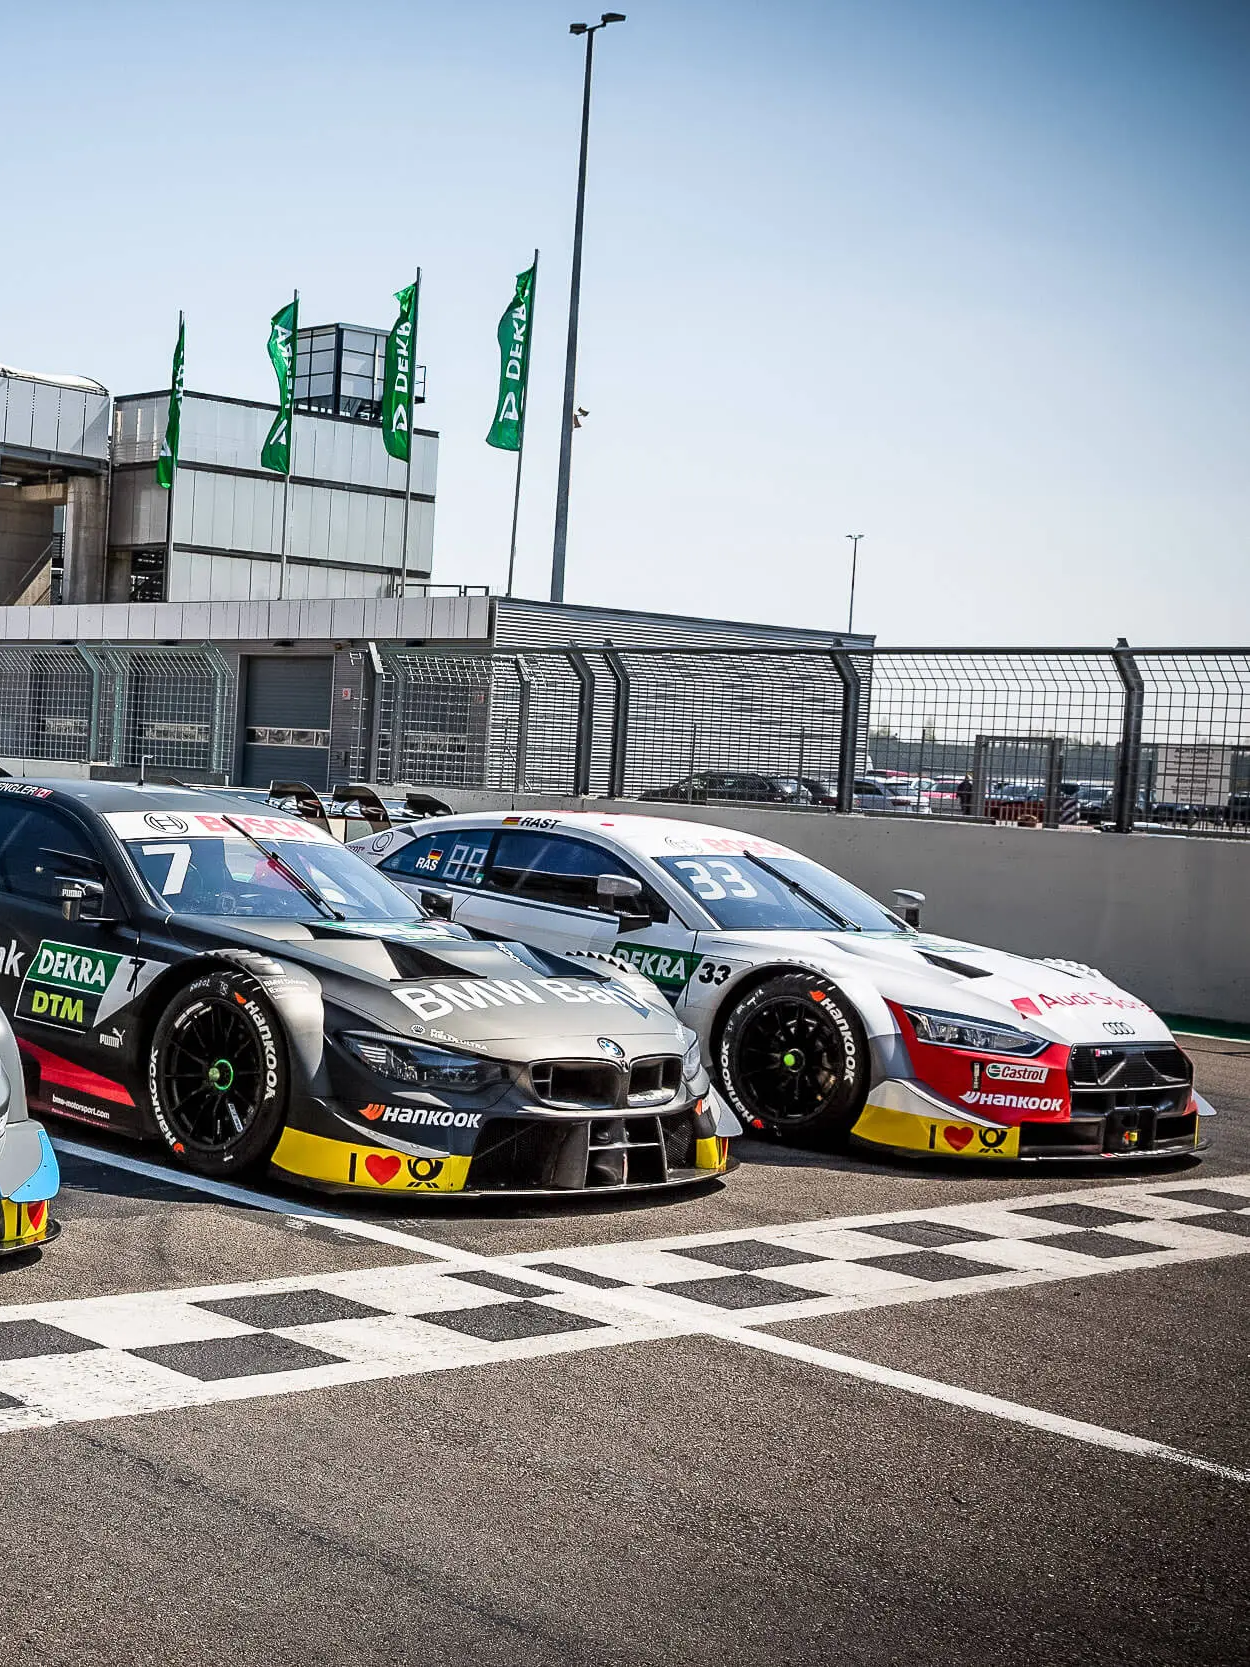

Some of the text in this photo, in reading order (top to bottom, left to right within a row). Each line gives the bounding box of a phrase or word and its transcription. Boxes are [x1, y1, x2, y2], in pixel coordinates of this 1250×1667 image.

[520, 817, 562, 829] RAST
[141, 843, 192, 896] 7
[415, 857, 439, 871] RAS
[673, 860, 758, 900] 33
[37, 948, 107, 988] DEKRA
[126, 959, 147, 993] 7
[698, 961, 732, 987] 33
[31, 990, 84, 1023] DTM
[389, 979, 547, 1022] BMW
[1037, 992, 1096, 1009] Audi
[1001, 1065, 1045, 1081] Castrol
